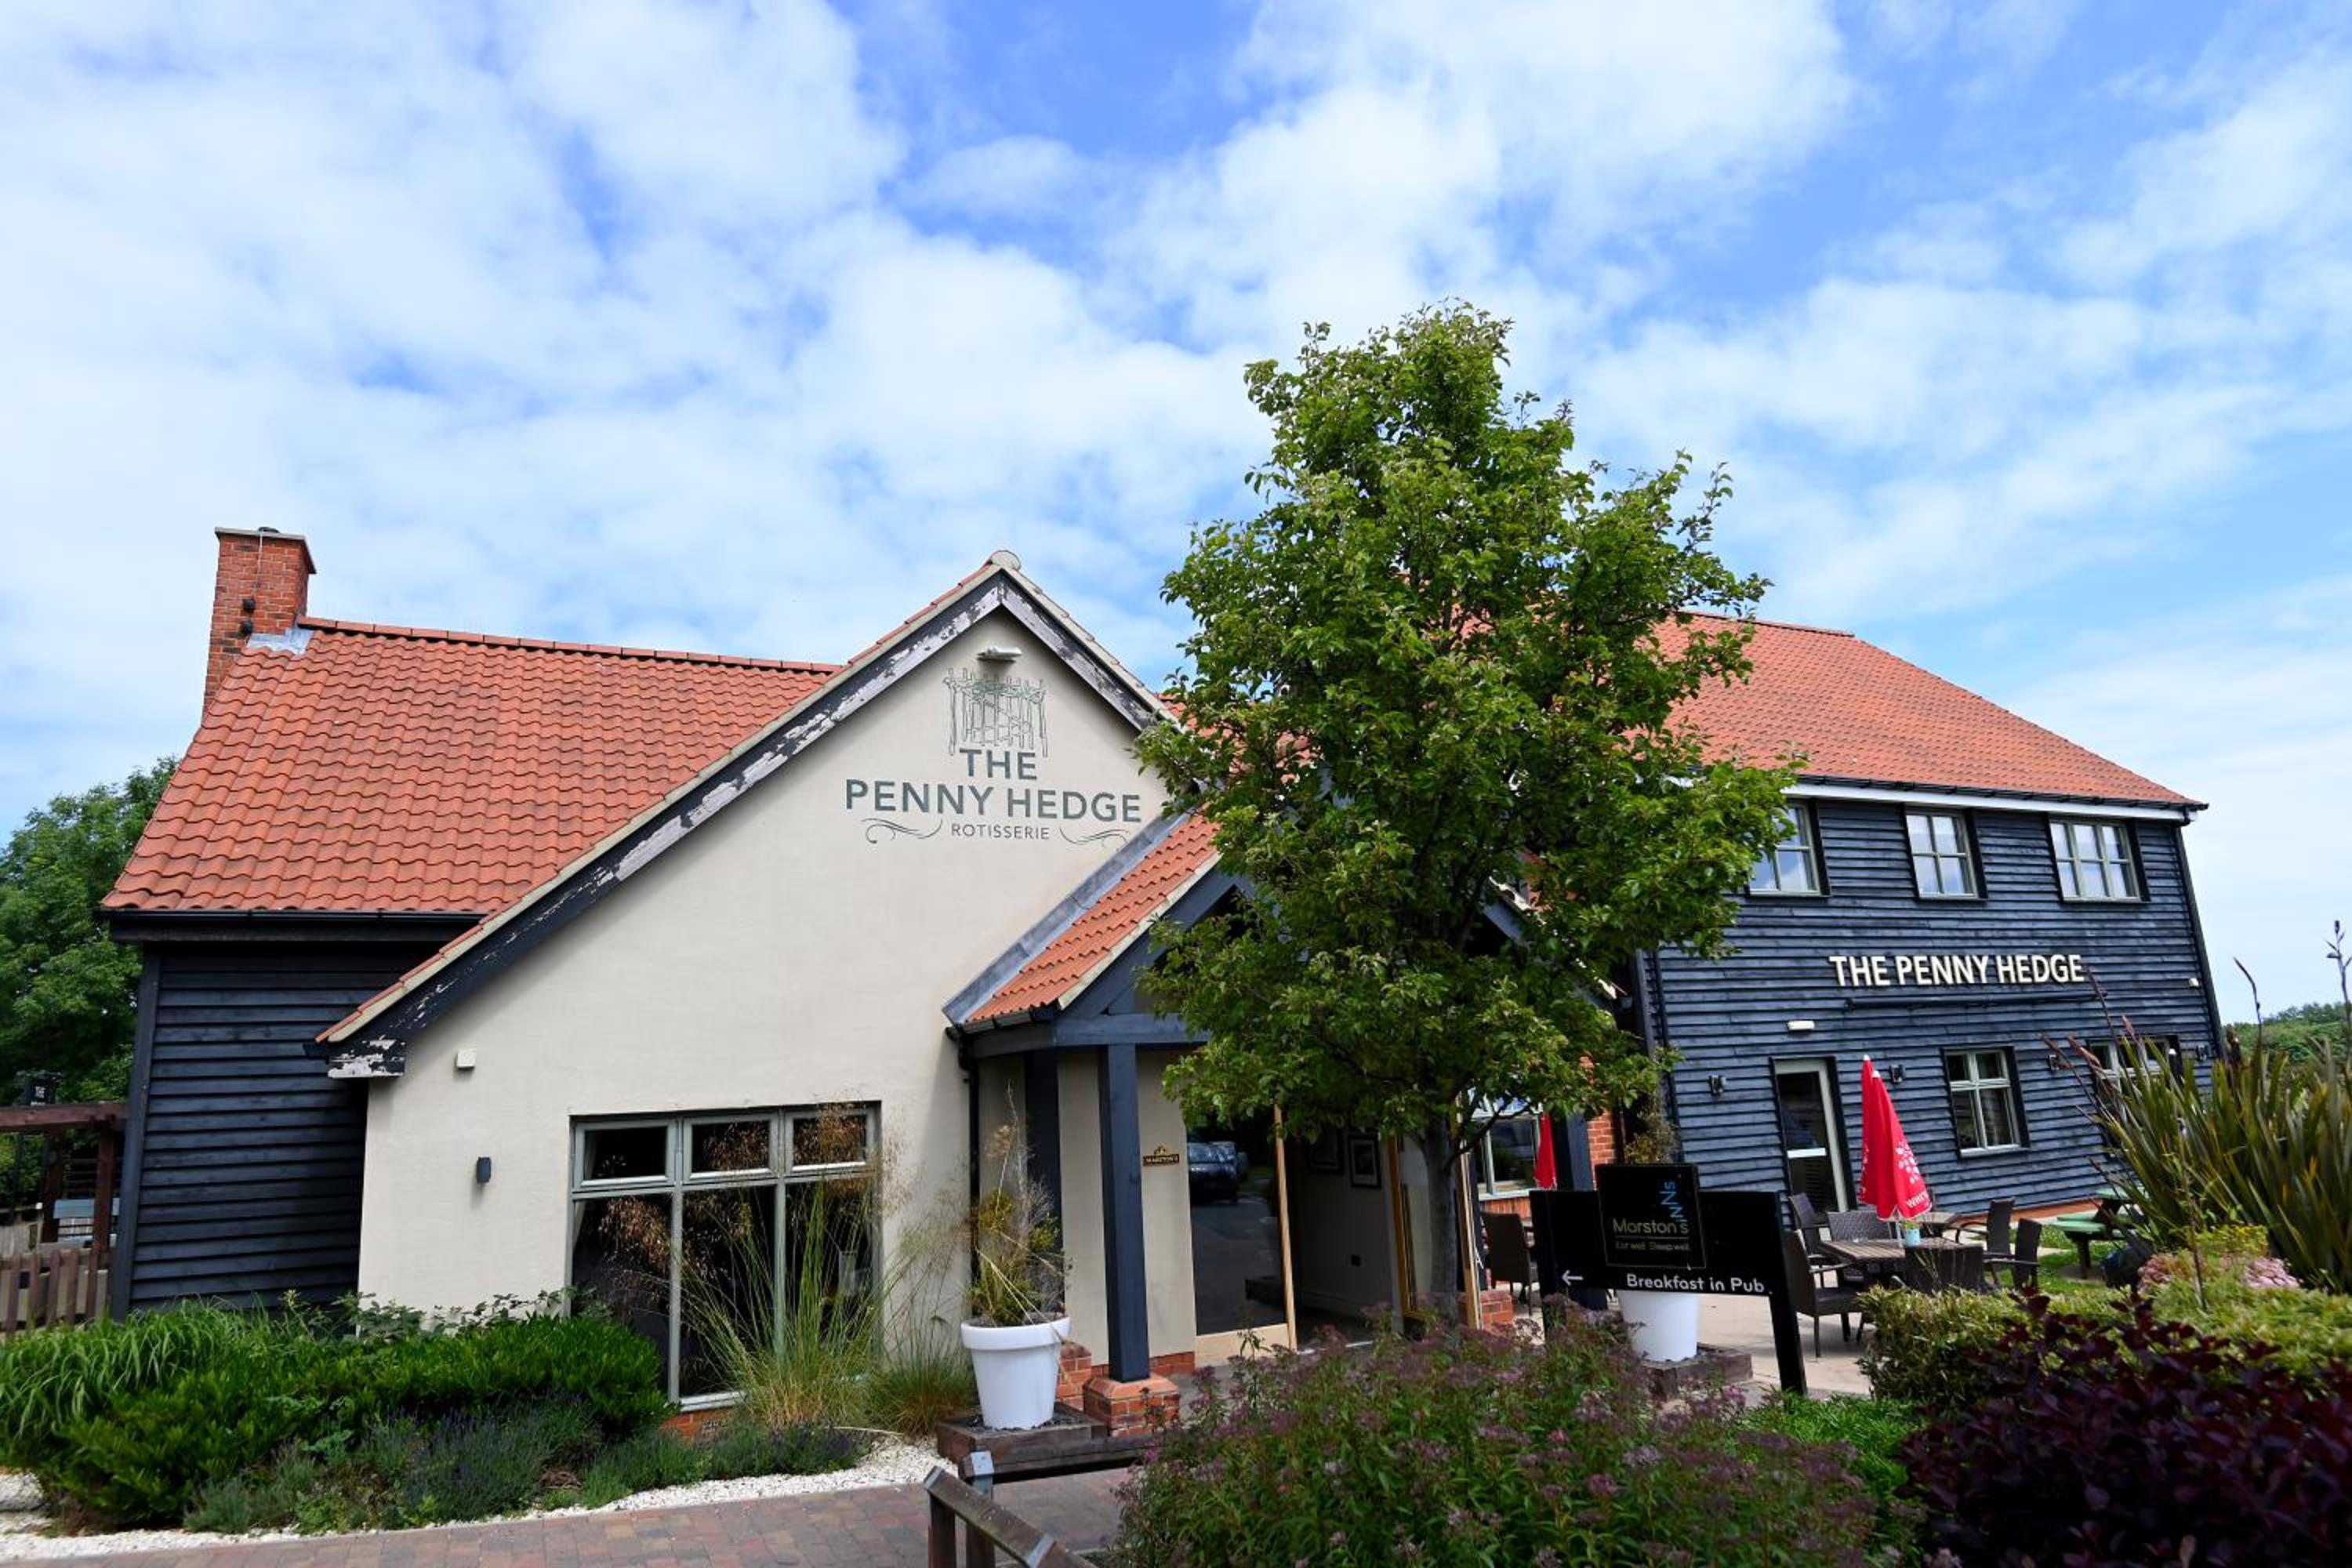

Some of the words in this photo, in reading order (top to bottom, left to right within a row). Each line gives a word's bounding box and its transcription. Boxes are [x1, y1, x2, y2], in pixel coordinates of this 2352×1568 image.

[959, 748, 1037, 781] THE
[846, 779, 993, 815] PENNY
[1007, 787, 1142, 823] HEDGE
[951, 822, 1050, 840] ROTISSERIE
[1828, 956, 1890, 987] THE
[1895, 954, 1989, 985] PENNY
[1996, 953, 2085, 983] HEDGE
[1627, 1273, 1704, 1290] Breakfast
[1709, 1277, 1725, 1291] in
[1730, 1277, 1765, 1293] Pub
